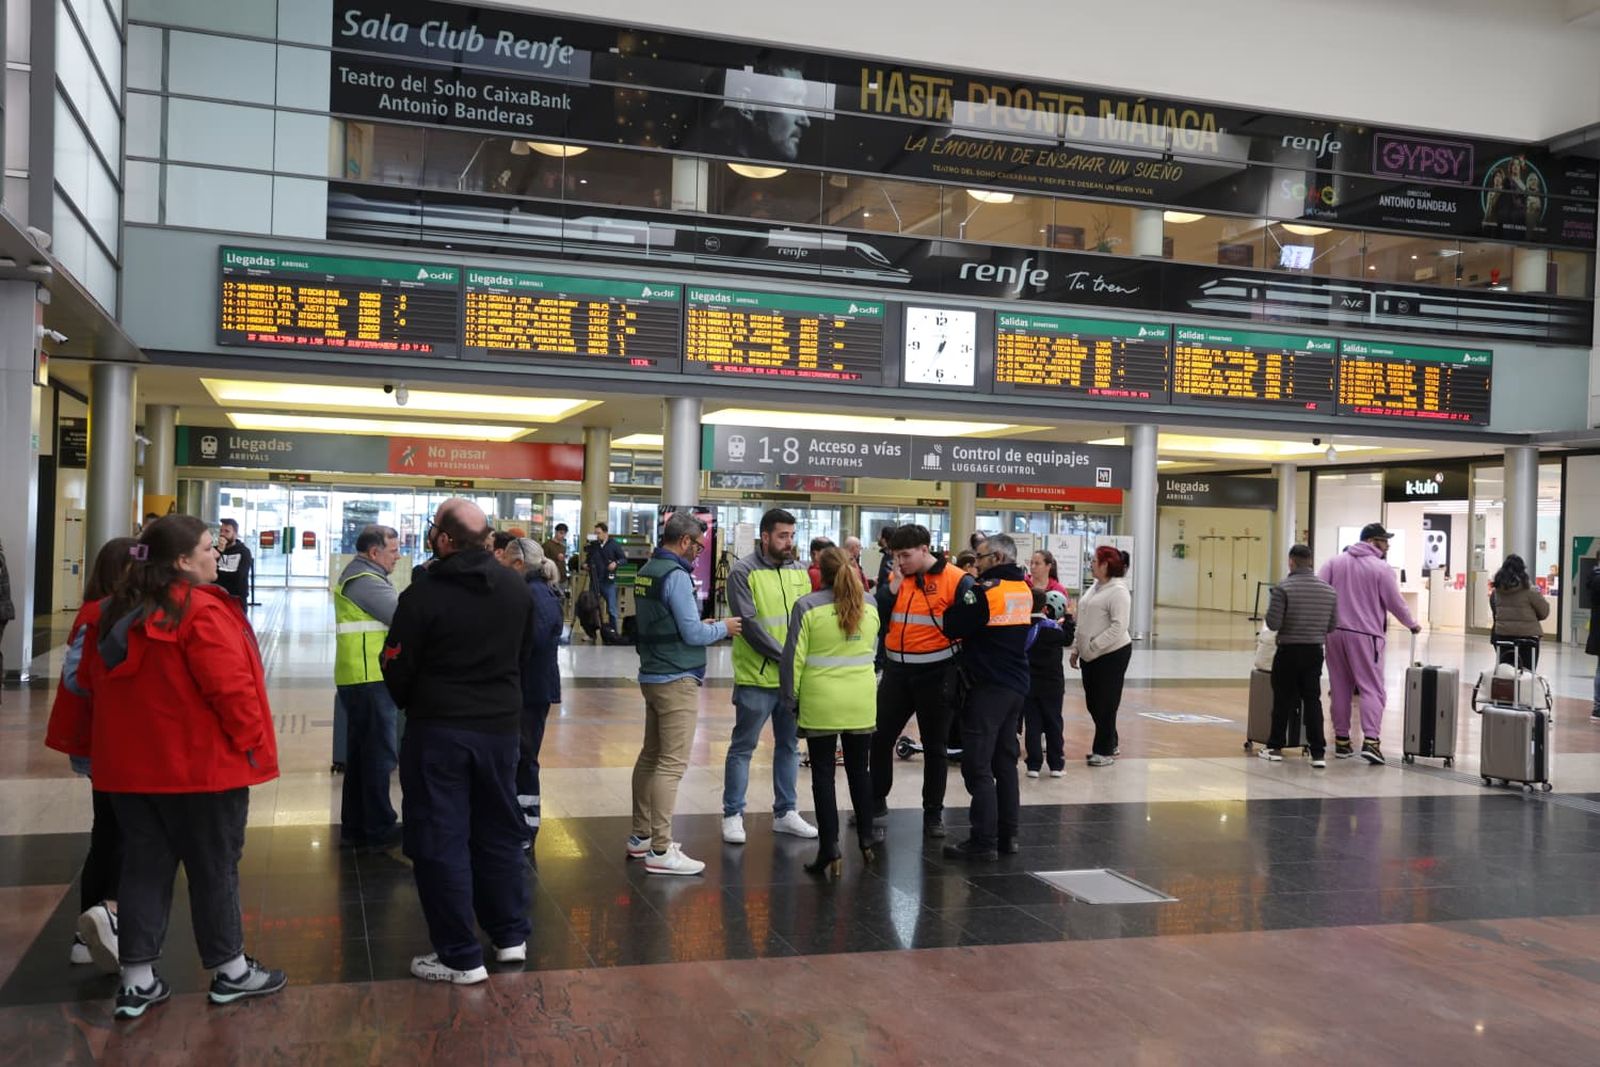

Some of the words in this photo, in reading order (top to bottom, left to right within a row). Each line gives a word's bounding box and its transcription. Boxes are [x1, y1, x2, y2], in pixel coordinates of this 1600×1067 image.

[341, 10, 409, 42] Sala
[420, 21, 484, 52] Club
[495, 30, 574, 68] Renfe
[339, 67, 395, 89] Teatro
[401, 75, 427, 93] del
[434, 79, 477, 98] Soho
[483, 85, 571, 110] CaixaBank
[379, 94, 448, 116] Antonio
[455, 102, 534, 126] Banderas
[1100, 97, 1218, 153] MÁLAGA
[1281, 132, 1342, 159] renfe
[904, 135, 928, 151] LA
[931, 138, 1006, 161] EMOCIÓN
[1011, 148, 1035, 165] DE
[1036, 151, 1106, 174] ENSAYAR
[1108, 159, 1130, 176] UN
[1134, 161, 1183, 182] SUEÑO
[1383, 142, 1466, 176] GYPSY
[1379, 195, 1415, 209] ANTONIO
[1417, 199, 1457, 213] BANDERAS
[226, 253, 276, 267] Llegadas
[778, 247, 808, 260] renfe
[430, 272, 454, 280] adif
[469, 273, 514, 286] Llegadas
[959, 257, 1049, 294] renfe
[1065, 271, 1090, 291] Tu
[1093, 274, 1140, 294] tren
[690, 291, 731, 303] Llegadas
[936, 317, 948, 326] 12
[1000, 317, 1028, 327] Salidas
[1178, 330, 1205, 340] Salidas
[912, 341, 920, 350] 9
[1343, 344, 1367, 353] Salidas
[936, 368, 944, 378] 6
[229, 436, 293, 452] Llegadas
[758, 436, 800, 464] 1-8
[809, 439, 856, 454] Acceso
[860, 443, 869, 455] a
[873, 440, 901, 456] vías
[229, 452, 270, 462] ARRIVALS
[428, 445, 446, 458] No
[451, 448, 488, 462] pasar
[952, 445, 1000, 461] Control
[1005, 448, 1021, 462] de
[1025, 451, 1090, 467] equipajes
[808, 456, 863, 468] PLATFORMS
[952, 464, 994, 474] LUGGAGE
[996, 465, 1036, 475] CONTROL
[1166, 480, 1210, 494] Llegadas
[1406, 479, 1439, 495] k-tuin
